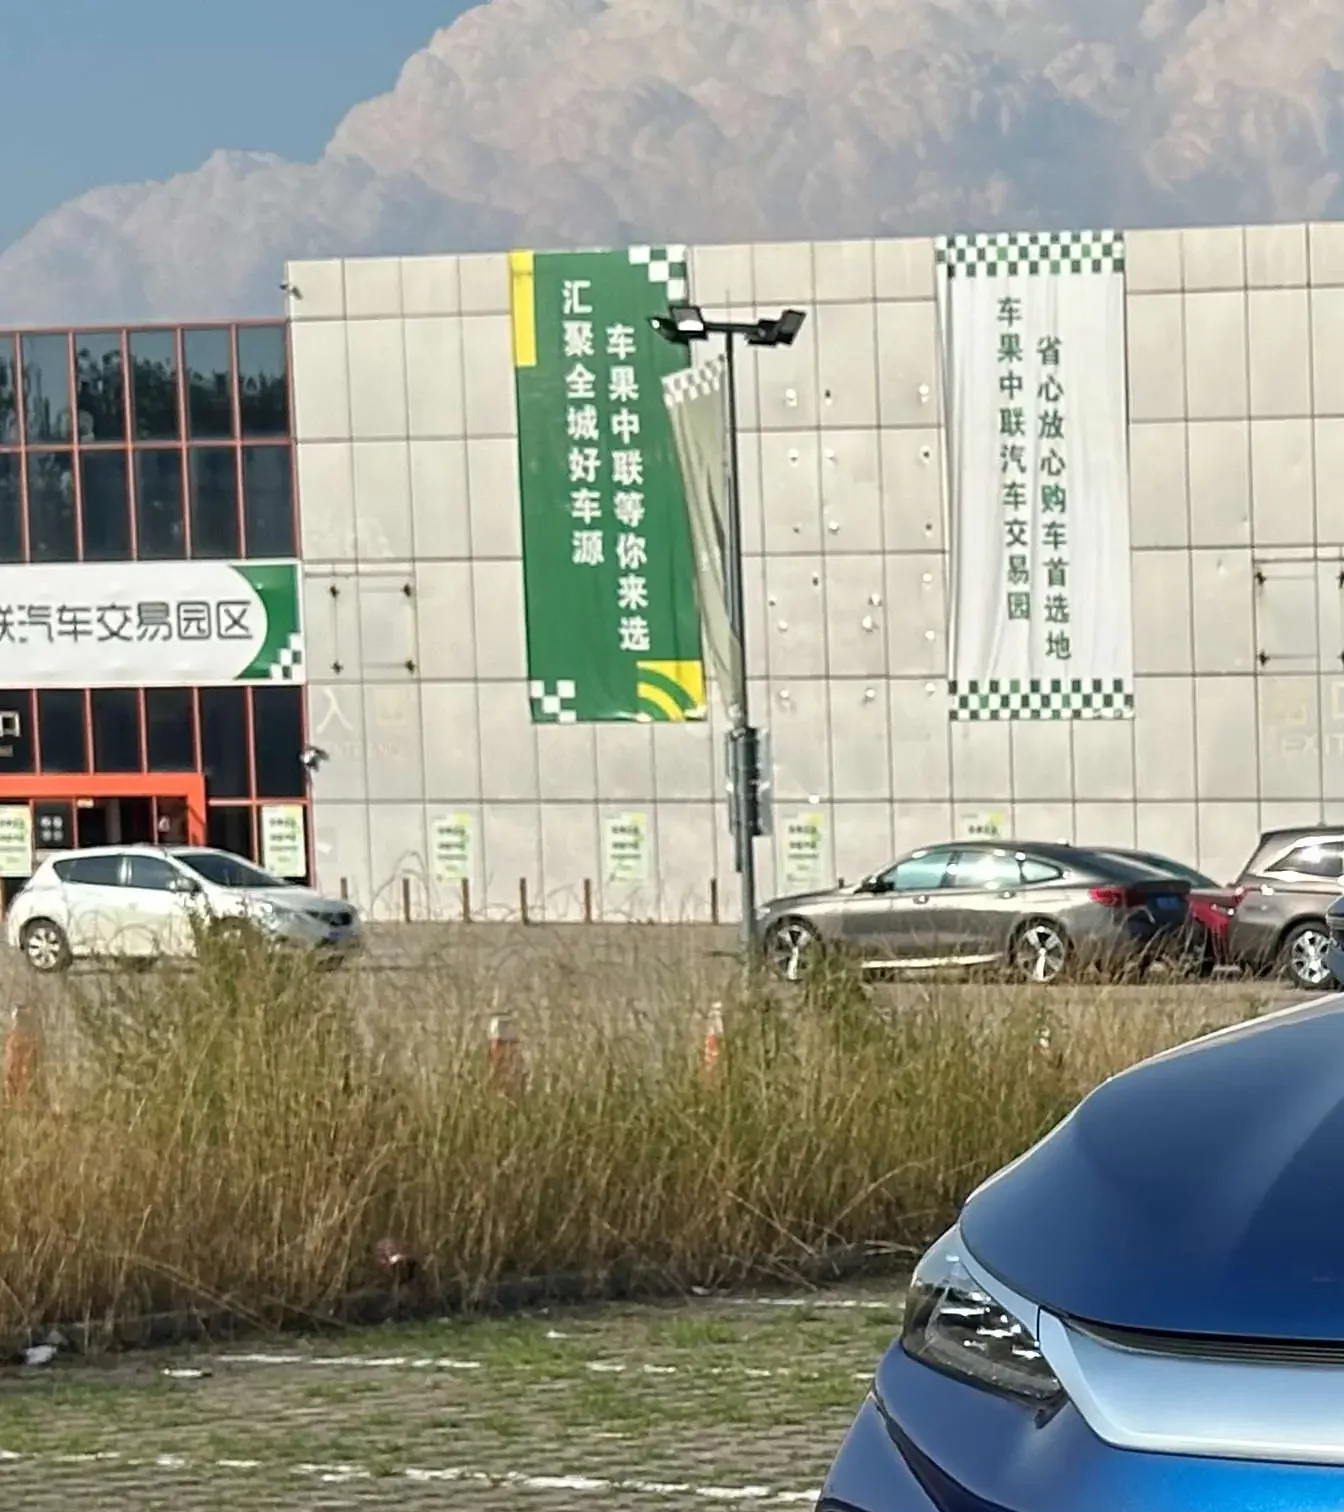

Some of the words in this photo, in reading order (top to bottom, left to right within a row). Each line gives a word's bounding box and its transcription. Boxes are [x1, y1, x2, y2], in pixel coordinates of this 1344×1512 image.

[562, 279, 604, 567] 汇聚全城好车源
[606, 322, 651, 652] 车果中联等你来选
[996, 296, 1030, 622] 车果中联汽车交易园
[1035, 335, 1071, 661] 省心放心购车首选地
